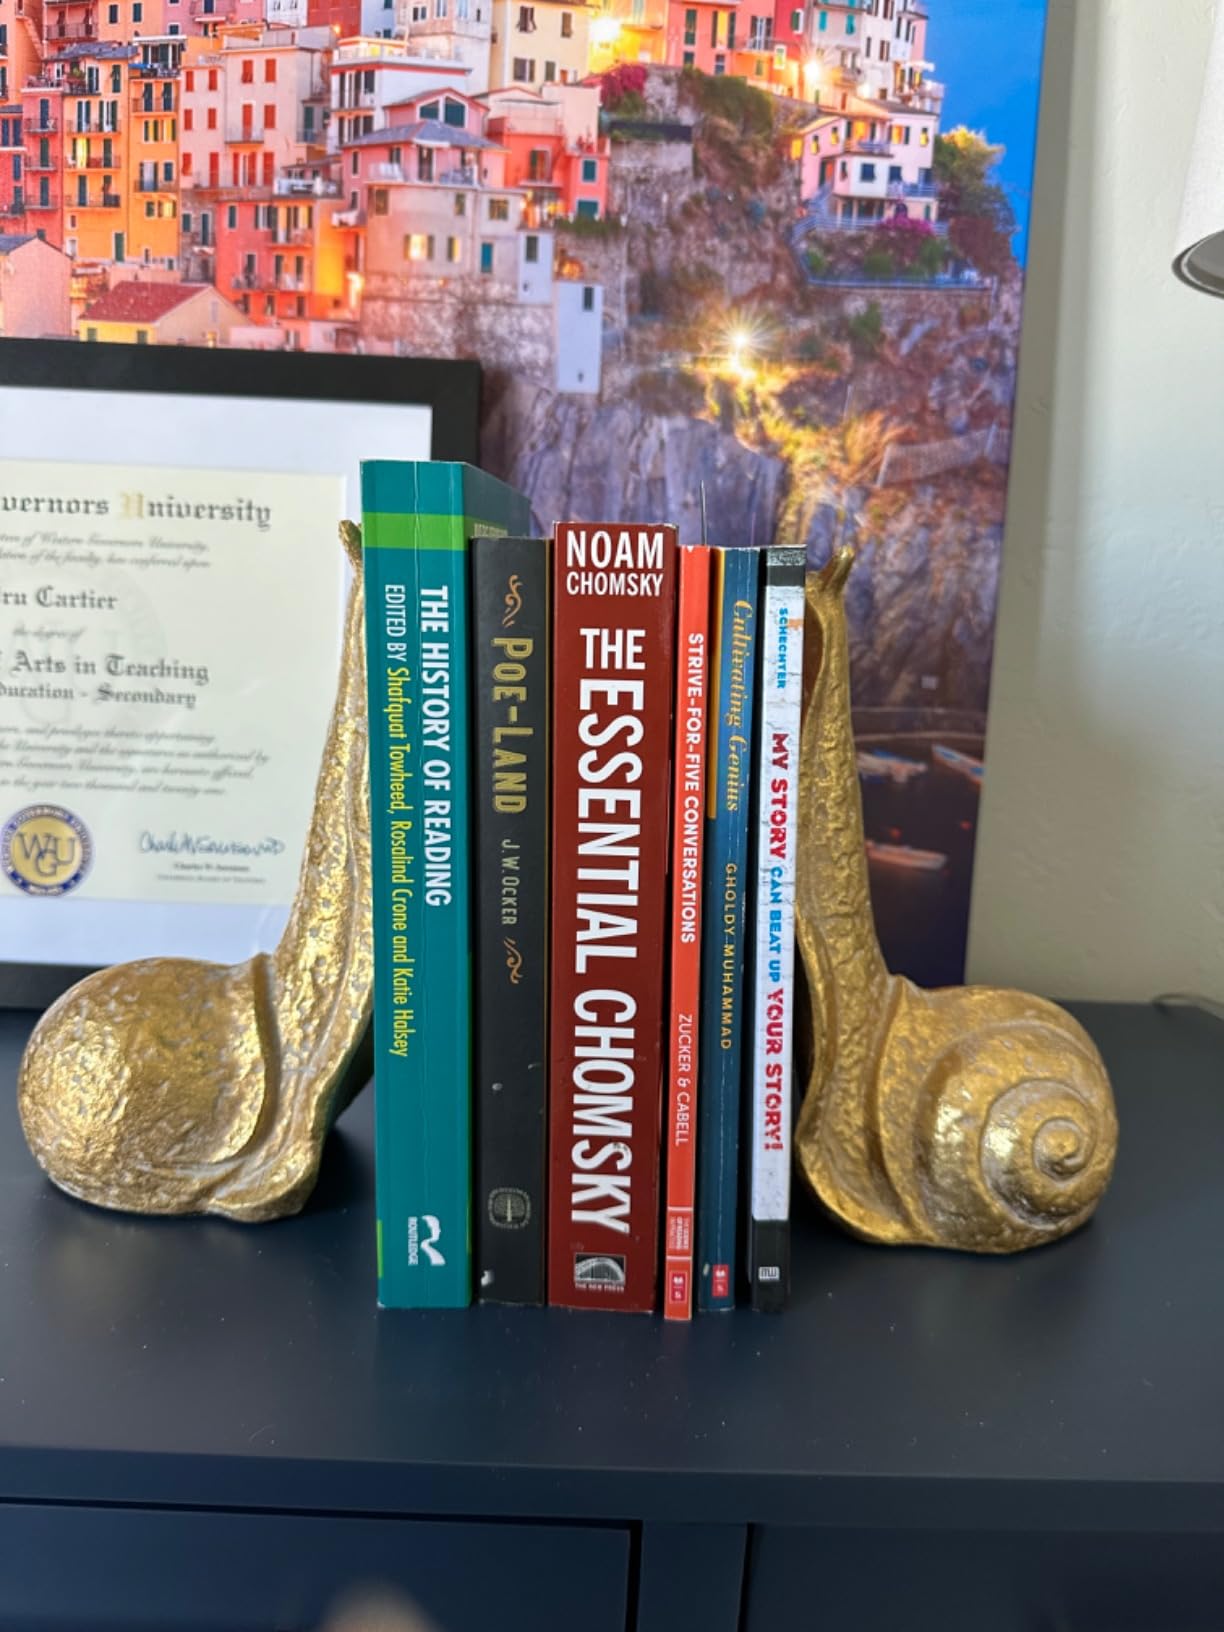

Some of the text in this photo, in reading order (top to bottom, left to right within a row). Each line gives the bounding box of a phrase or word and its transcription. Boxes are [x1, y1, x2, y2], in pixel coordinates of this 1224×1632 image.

[118, 491, 272, 531] University
[566, 530, 664, 570] NOAM
[566, 571, 664, 597] CHOMSKY
[11, 649, 210, 686] Arts in Teaching
[36, 585, 118, 610] Cartier
[777, 607, 789, 690] SCHECHTER
[95, 682, 197, 710] Secondary
[420, 585, 452, 906] THE HISTORY OF READING
[492, 637, 534, 815] POE-LAND
[726, 599, 753, 812] Cultivating Genius
[382, 584, 416, 1057] EDITED BY Shafquat Towheed, Rosalind Crone and Katie Halsey
[680, 632, 704, 944] STRIVE-FOR-FIVE CONVERSATIONS
[571, 627, 647, 1238] THE ESSENTIAL CHOMSKY
[720, 863, 737, 1049] GHOLDY MUHAMMAD
[764, 732, 790, 1152] MY STORY CAN BEAT UP YOUR STORY!
[675, 1013, 693, 1147] ZUCKER & CABELL
